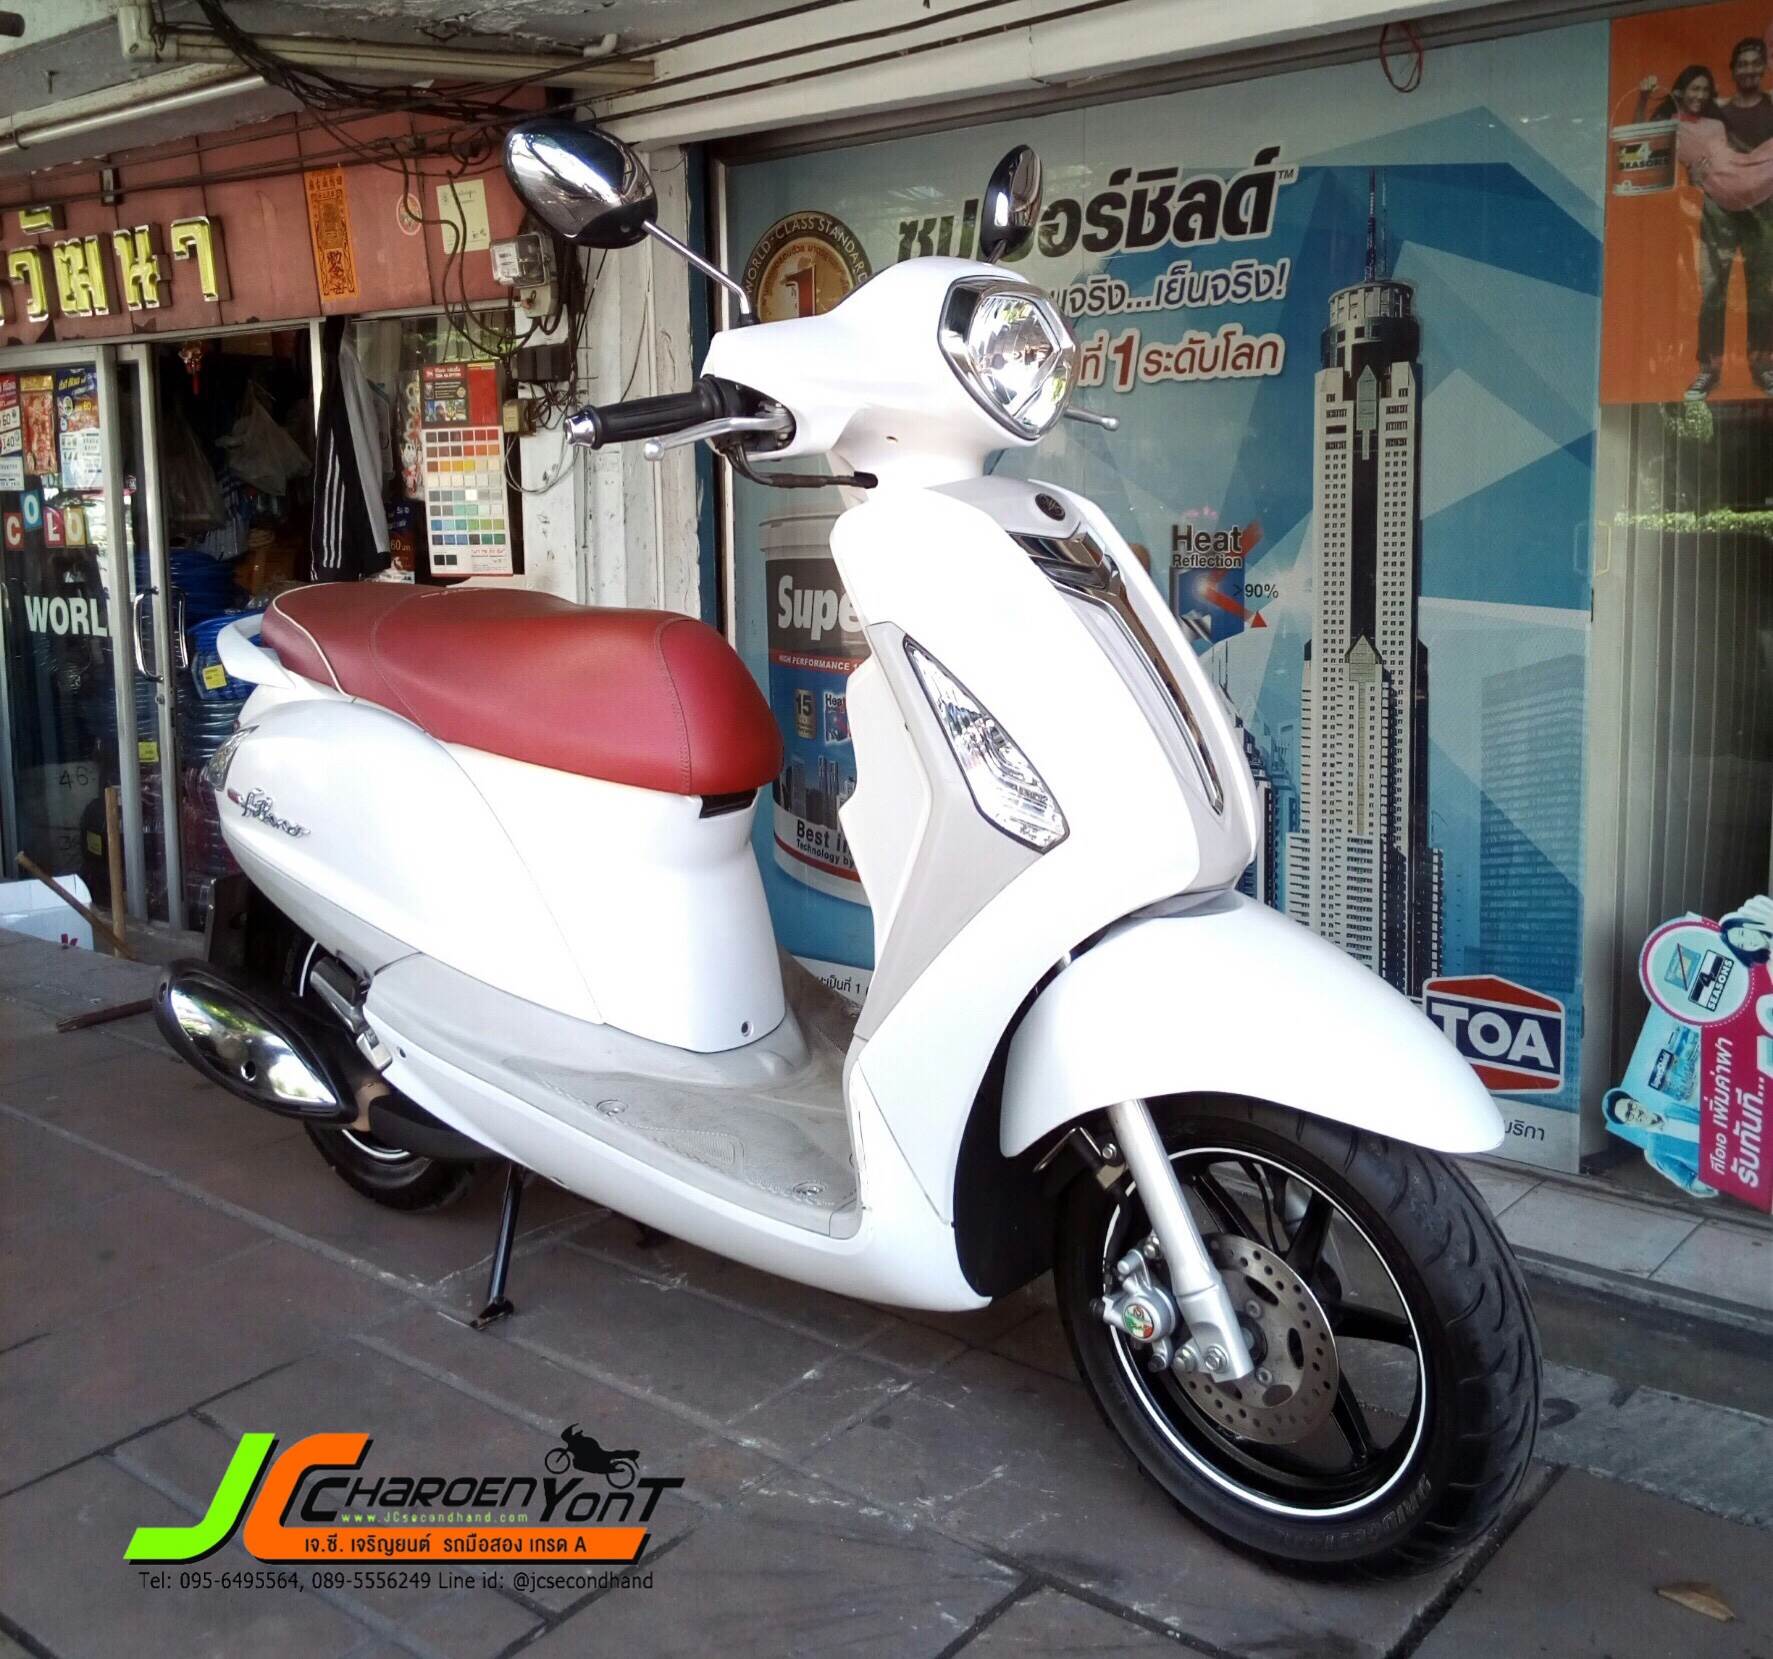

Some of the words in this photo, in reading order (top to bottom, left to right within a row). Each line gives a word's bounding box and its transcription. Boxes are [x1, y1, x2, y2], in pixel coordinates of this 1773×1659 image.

[1113, 335, 1136, 386] 1
[1143, 331, 1279, 377] ระดับโลก
[1171, 524, 1242, 552] Heat
[1172, 554, 1242, 568] Reflection
[792, 656, 850, 671] PERFORMANCE
[796, 820, 830, 849] Best
[796, 838, 840, 865] Technology
[1707, 958, 1734, 1011] SEASONS
[1431, 1002, 1555, 1069] TOA
